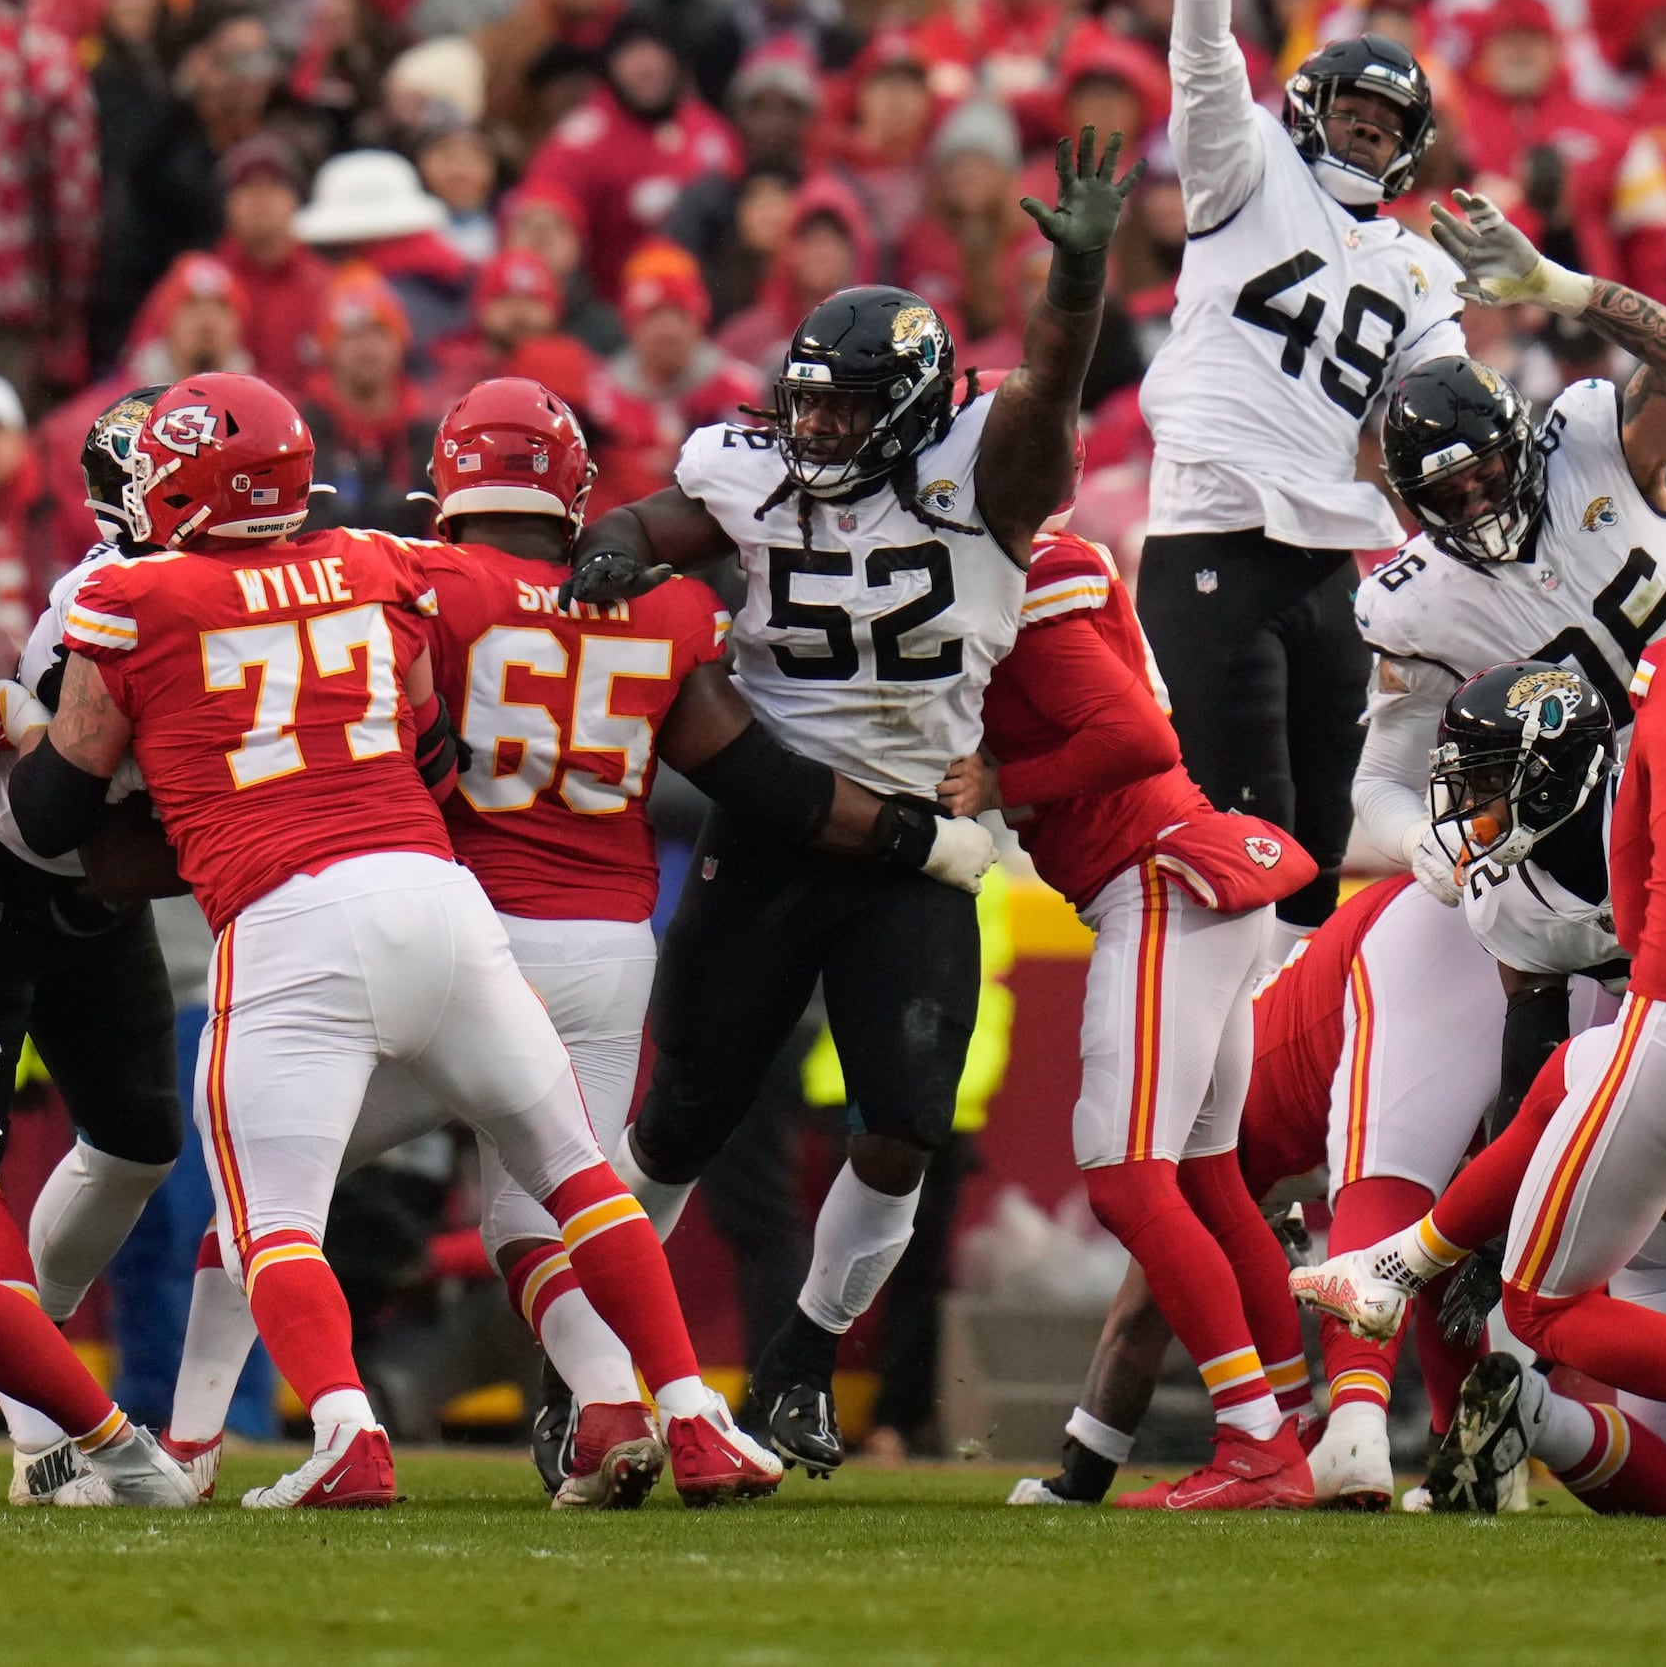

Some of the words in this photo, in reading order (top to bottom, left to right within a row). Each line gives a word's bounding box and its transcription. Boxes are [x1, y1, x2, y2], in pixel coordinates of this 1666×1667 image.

[1234, 250, 1407, 420] 49
[234, 477, 248, 490] 16
[247, 520, 285, 534] INSPIRE
[232, 556, 354, 615] WYLIE
[767, 542, 965, 682] 52
[200, 602, 402, 791] 77
[459, 626, 674, 816] 65
